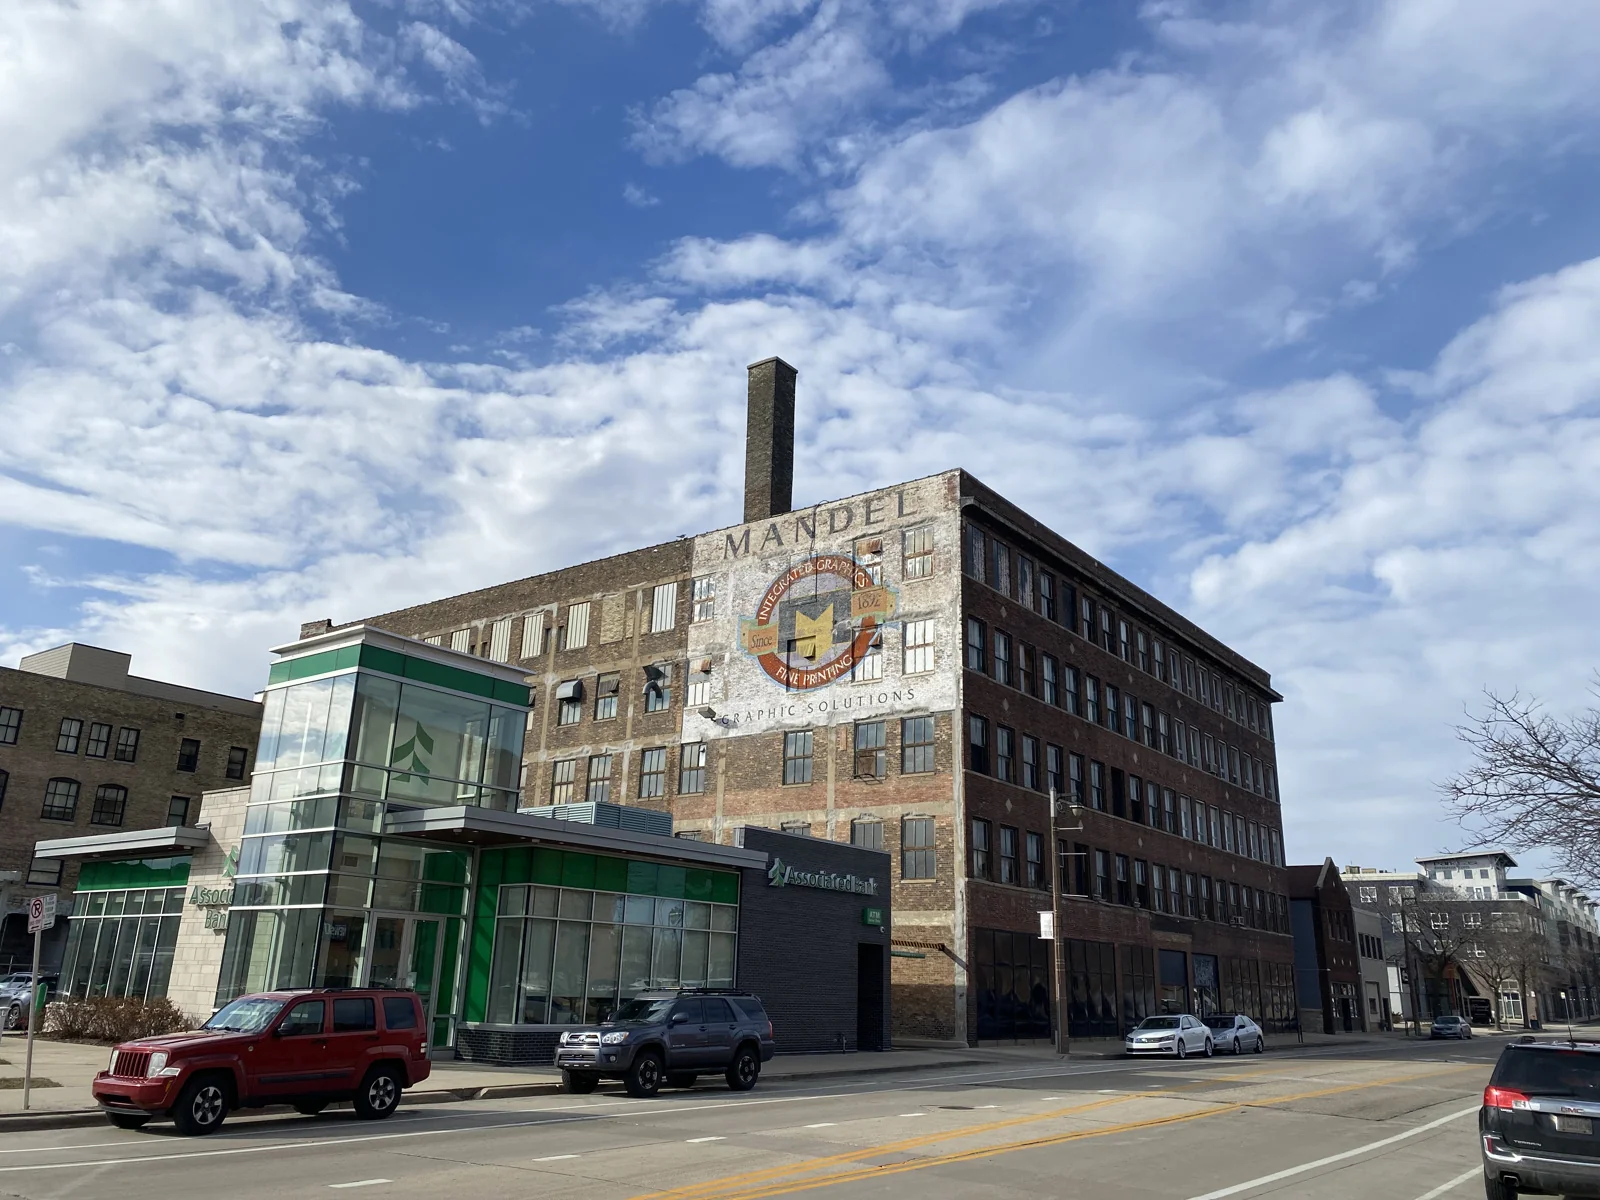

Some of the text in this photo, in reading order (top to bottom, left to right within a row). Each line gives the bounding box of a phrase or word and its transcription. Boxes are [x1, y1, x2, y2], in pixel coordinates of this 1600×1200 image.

[723, 490, 917, 560] MANDEL
[758, 561, 814, 621] INTEGRATED
[857, 593, 881, 610] 1892
[751, 633, 773, 649] Since
[776, 654, 854, 686] FINE PRINTING
[721, 688, 915, 725] GRAPHIC SOLUTIONS
[869, 911, 881, 919] ATM
[1560, 1106, 1585, 1114] GMC
